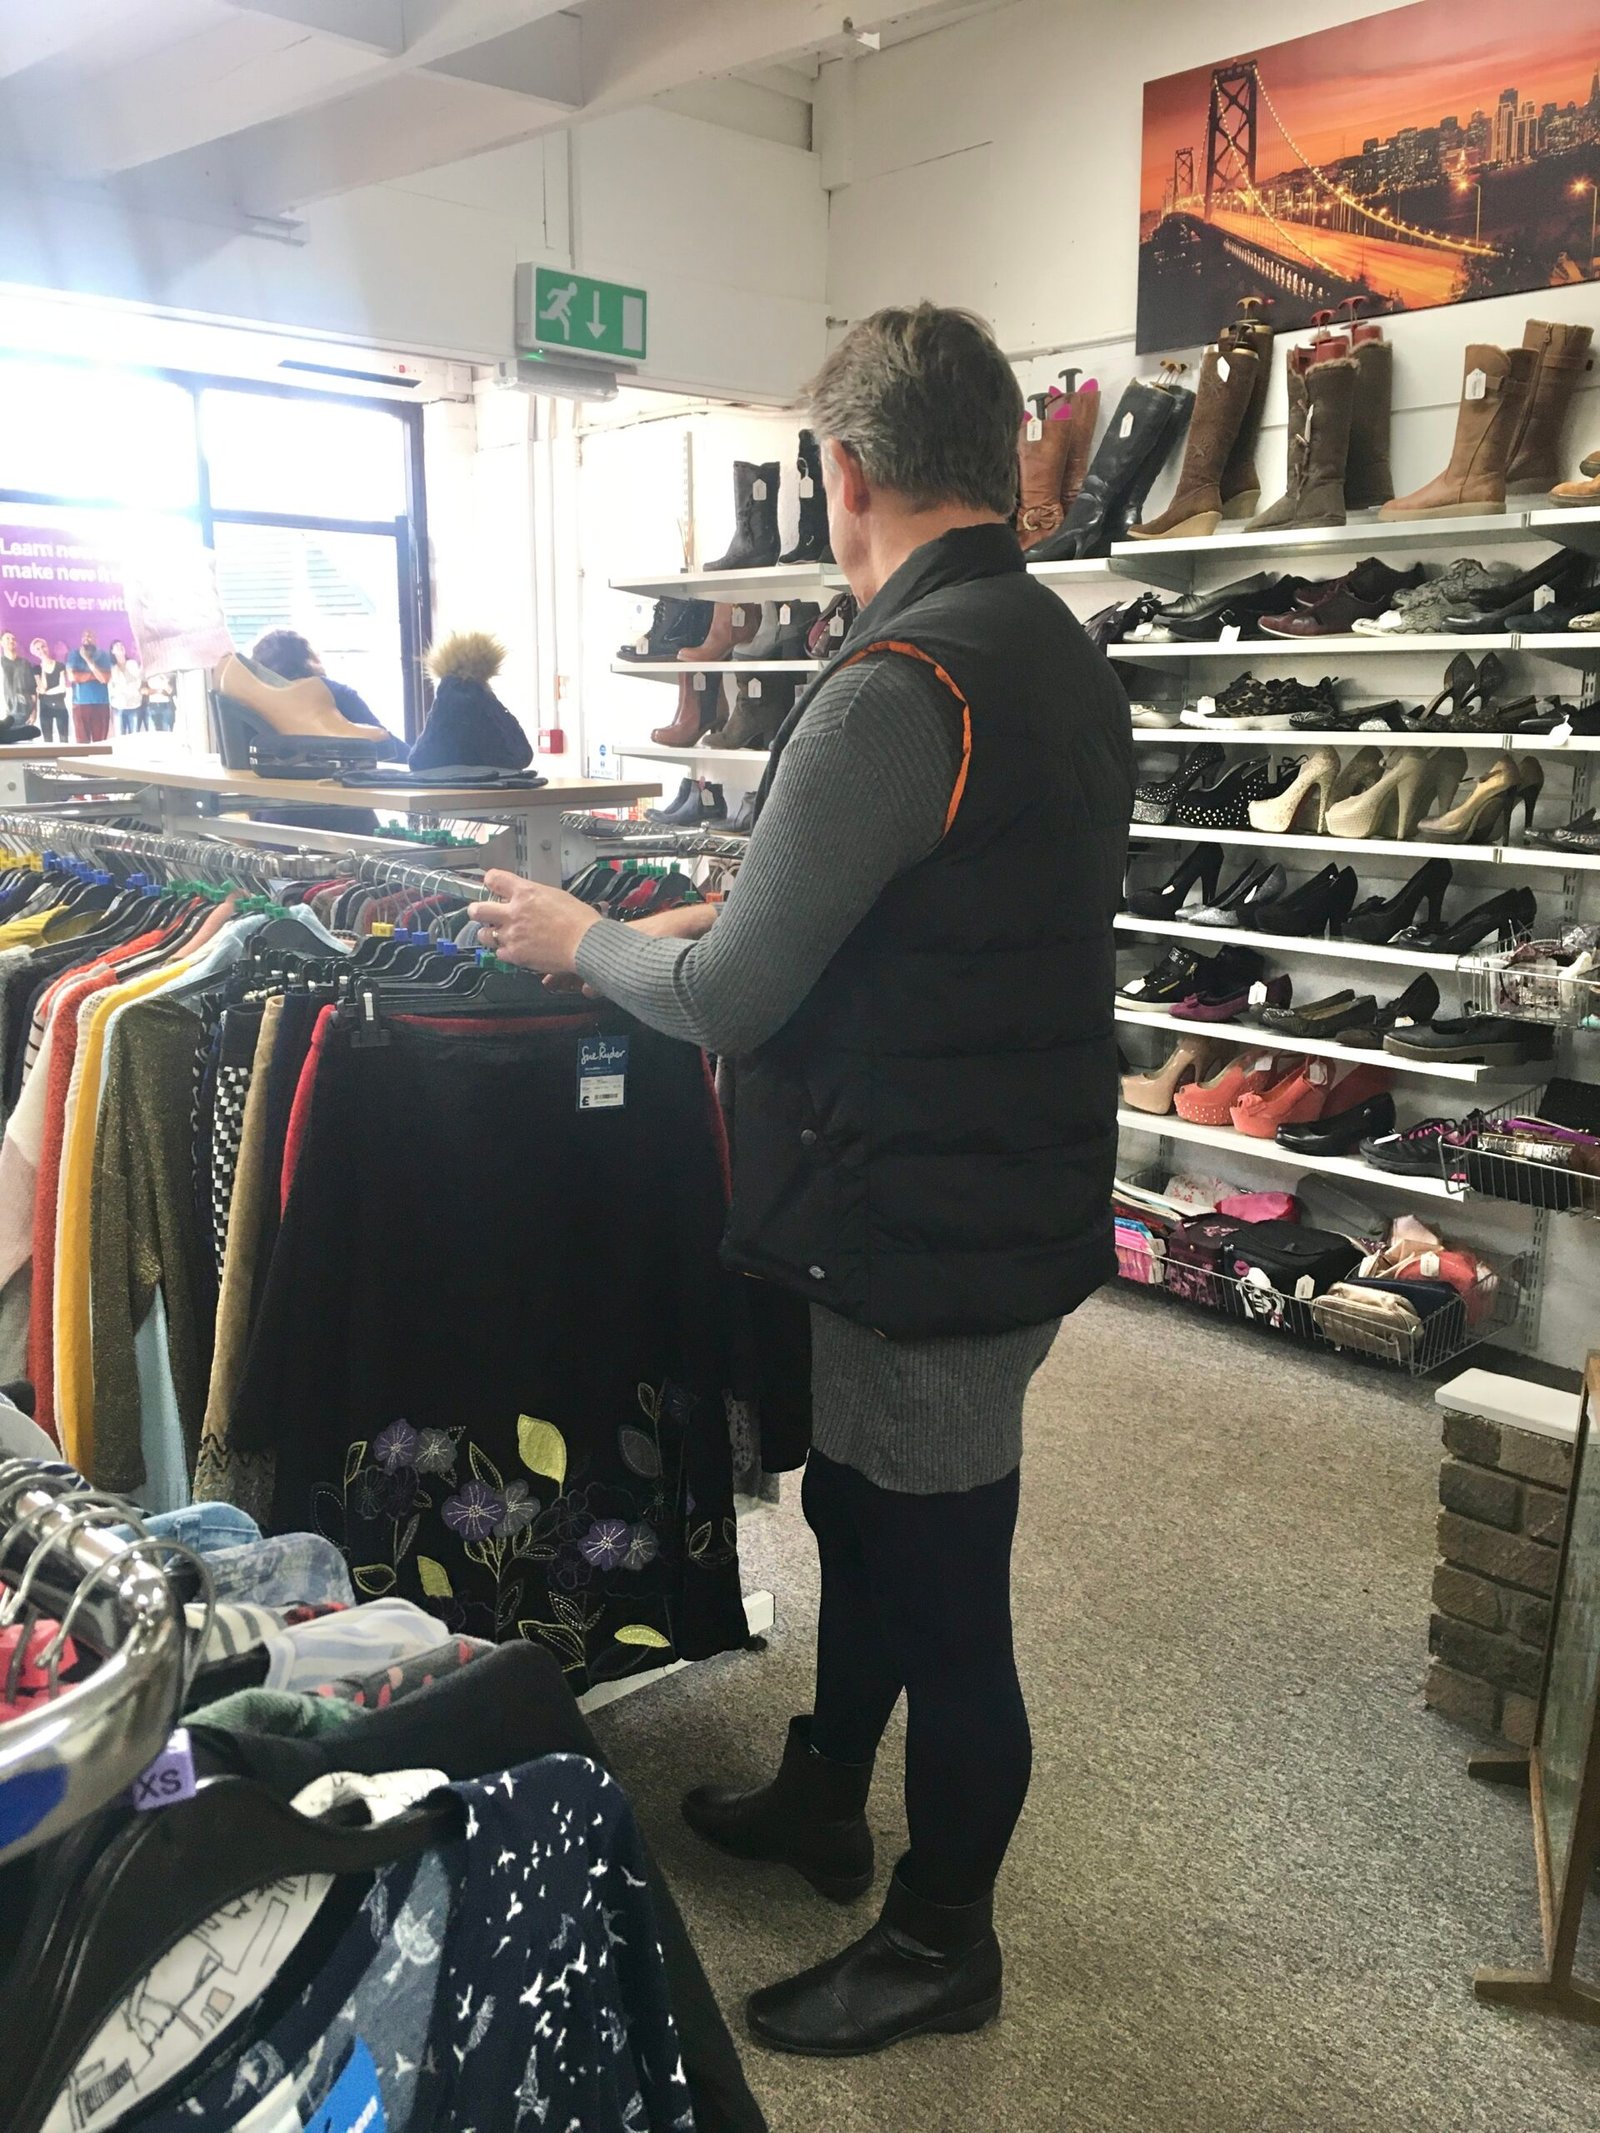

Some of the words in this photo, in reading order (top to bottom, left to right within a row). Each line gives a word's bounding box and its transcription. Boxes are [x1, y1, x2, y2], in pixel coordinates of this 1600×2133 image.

[0, 537, 54, 557] Learn
[2, 562, 54, 580] make
[56, 566, 97, 583] new
[4, 590, 95, 611] Volunteer
[98, 596, 125, 611] wit
[598, 1046, 625, 1064] Ryder
[138, 1769, 181, 1802] XS
